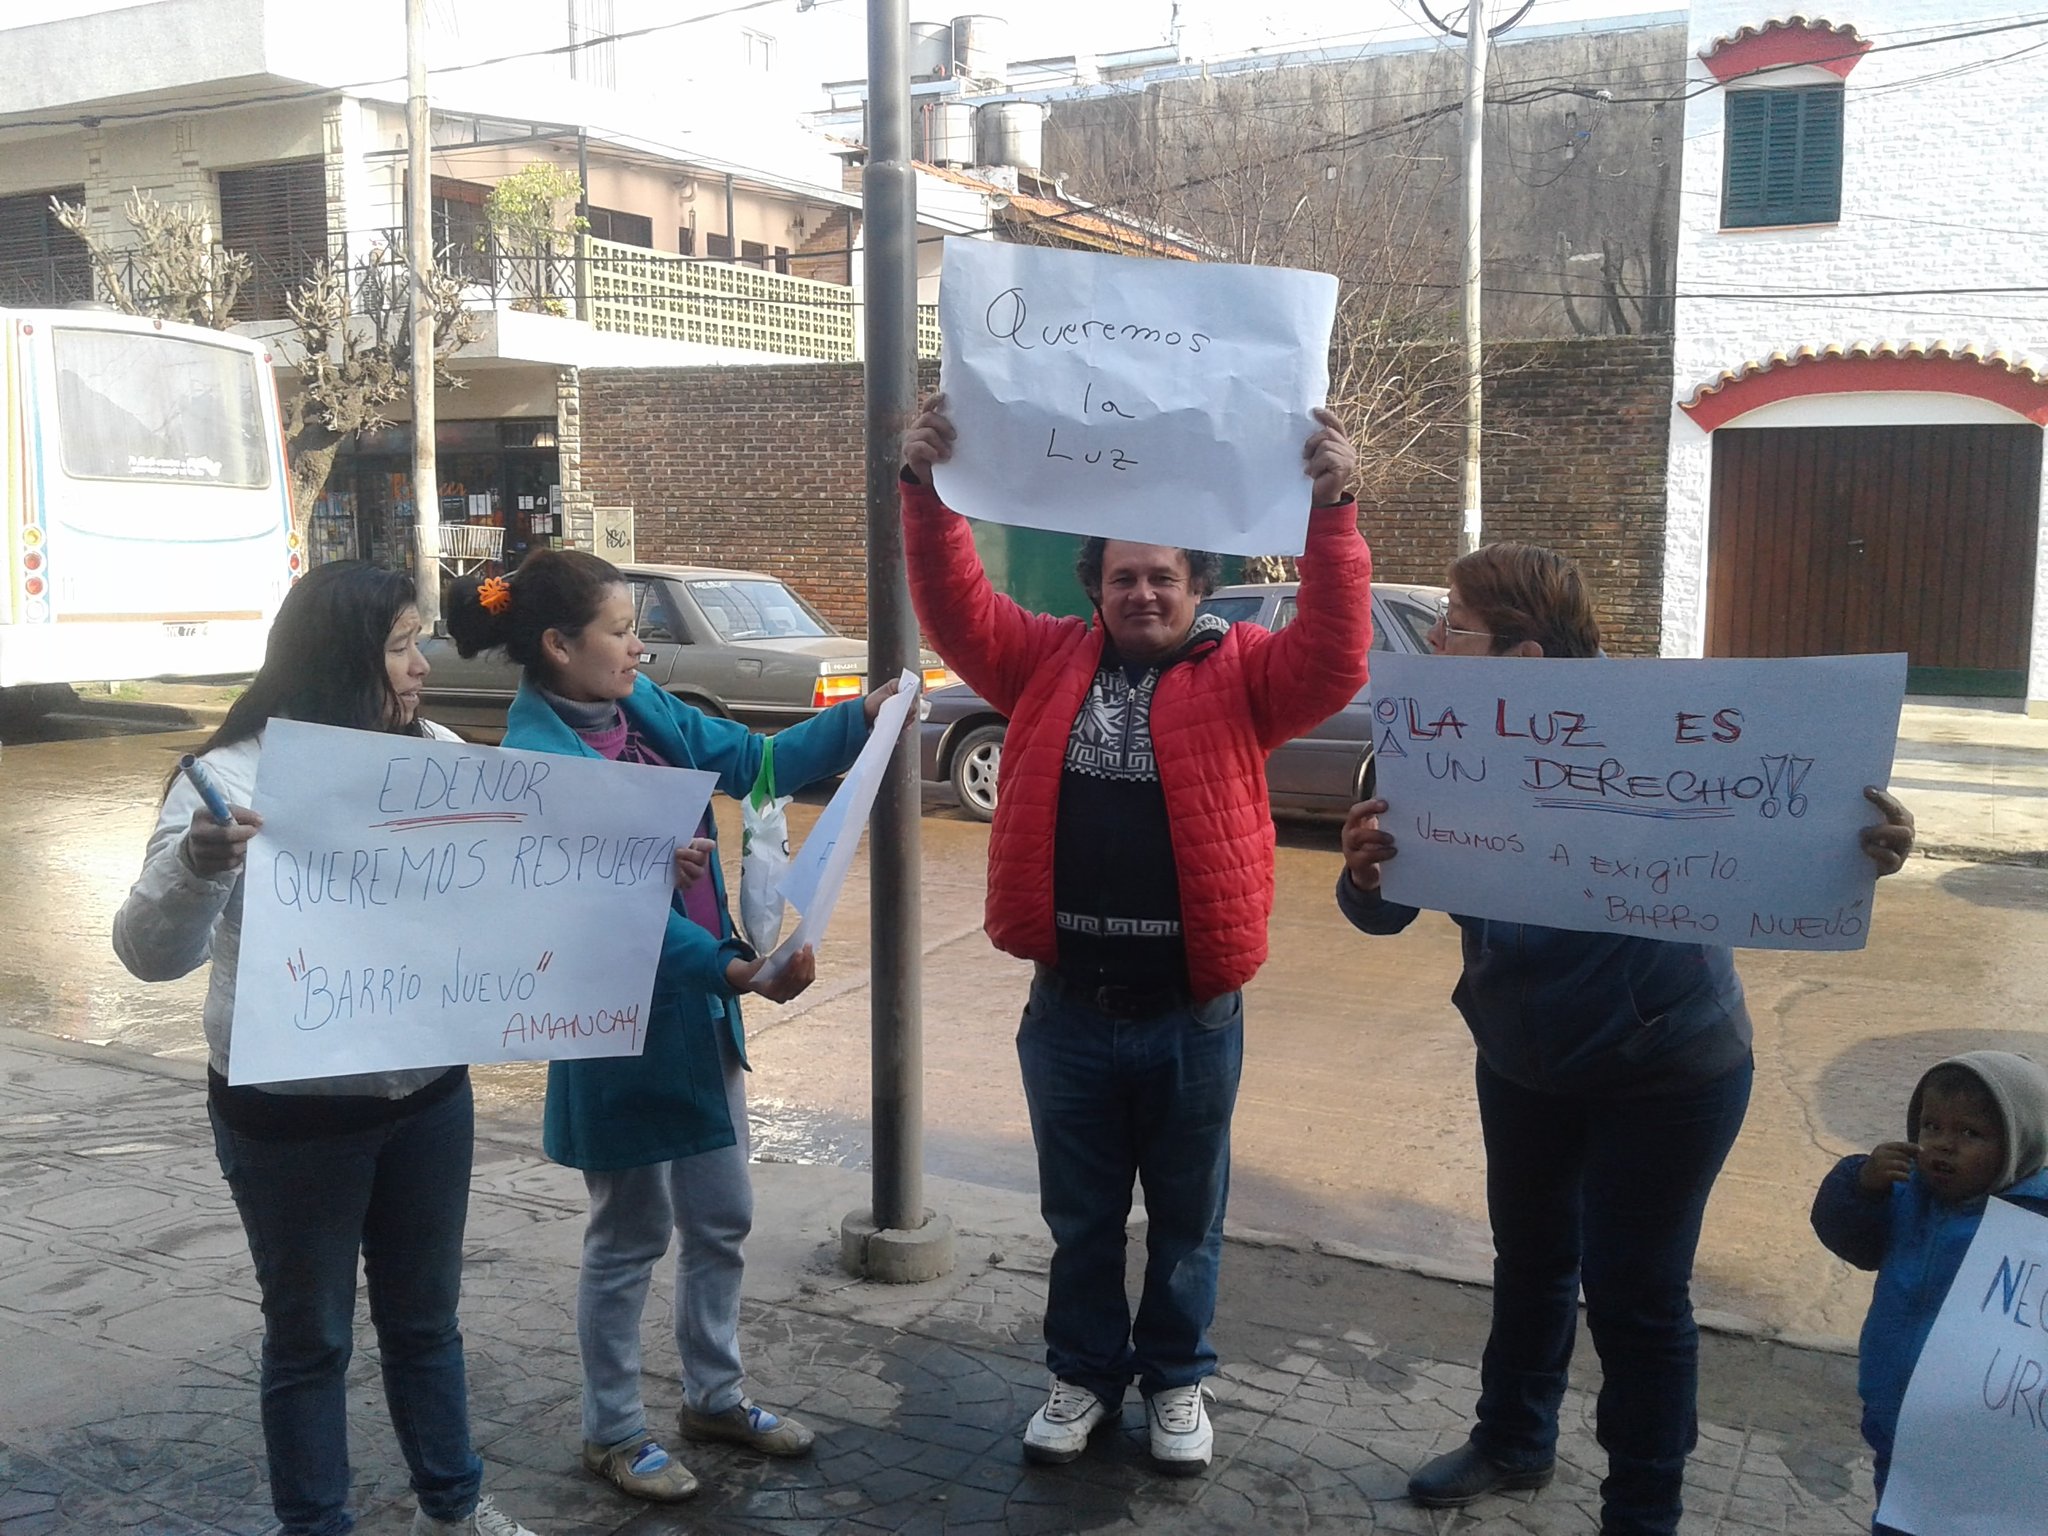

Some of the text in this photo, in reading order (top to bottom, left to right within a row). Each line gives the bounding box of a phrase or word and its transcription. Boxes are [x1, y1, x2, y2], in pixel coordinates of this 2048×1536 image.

[986, 287, 1210, 352] Queremos
[1083, 382, 1135, 419] la
[1495, 698, 1606, 748] LUZ
[1675, 708, 1745, 743] ES
[378, 757, 551, 815] EDENOR
[1426, 752, 1486, 782] UN
[274, 834, 676, 912] QUEREMOS RESPUESTA
[1549, 843, 1570, 867] A
